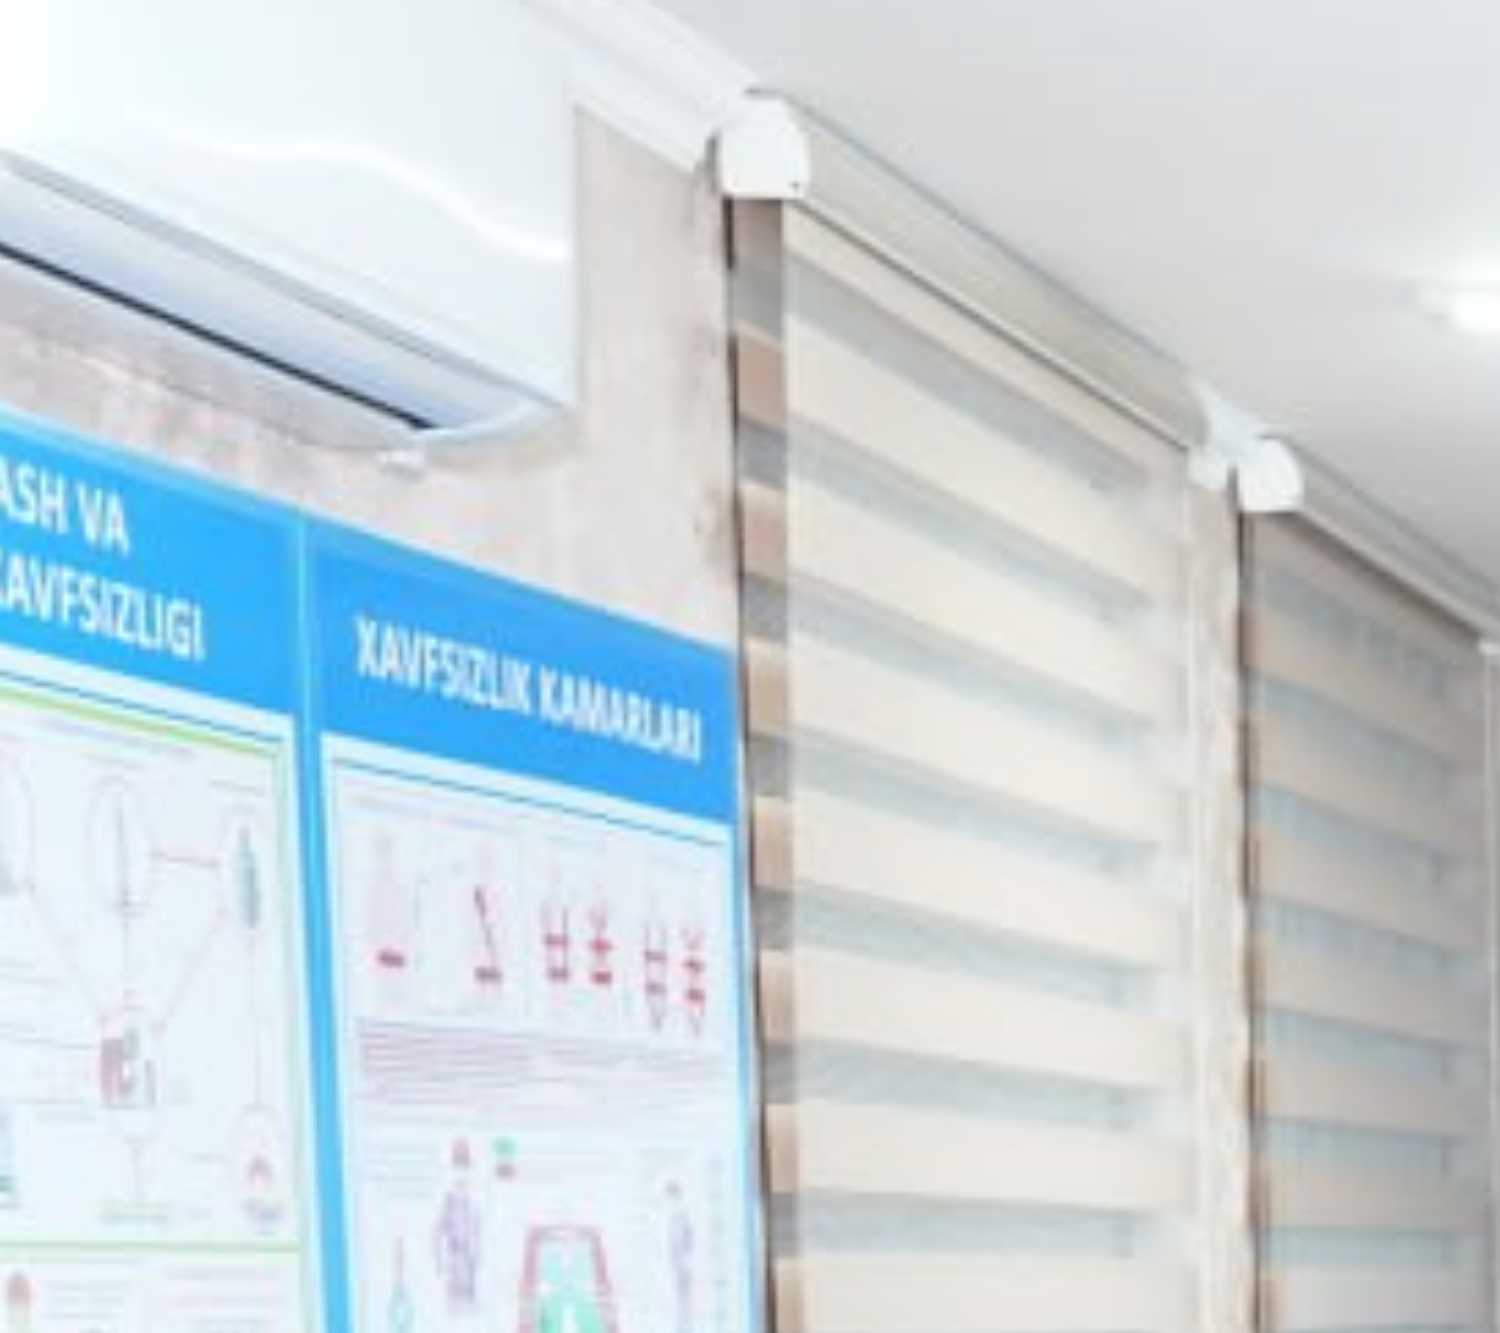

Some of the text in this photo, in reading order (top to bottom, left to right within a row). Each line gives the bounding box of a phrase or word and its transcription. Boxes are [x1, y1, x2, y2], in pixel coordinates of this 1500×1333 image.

[77, 481, 130, 556] VA
[0, 552, 206, 662] AVFSIZLIGI
[355, 613, 702, 766] XAVFSIZLIK KAMARLARI
